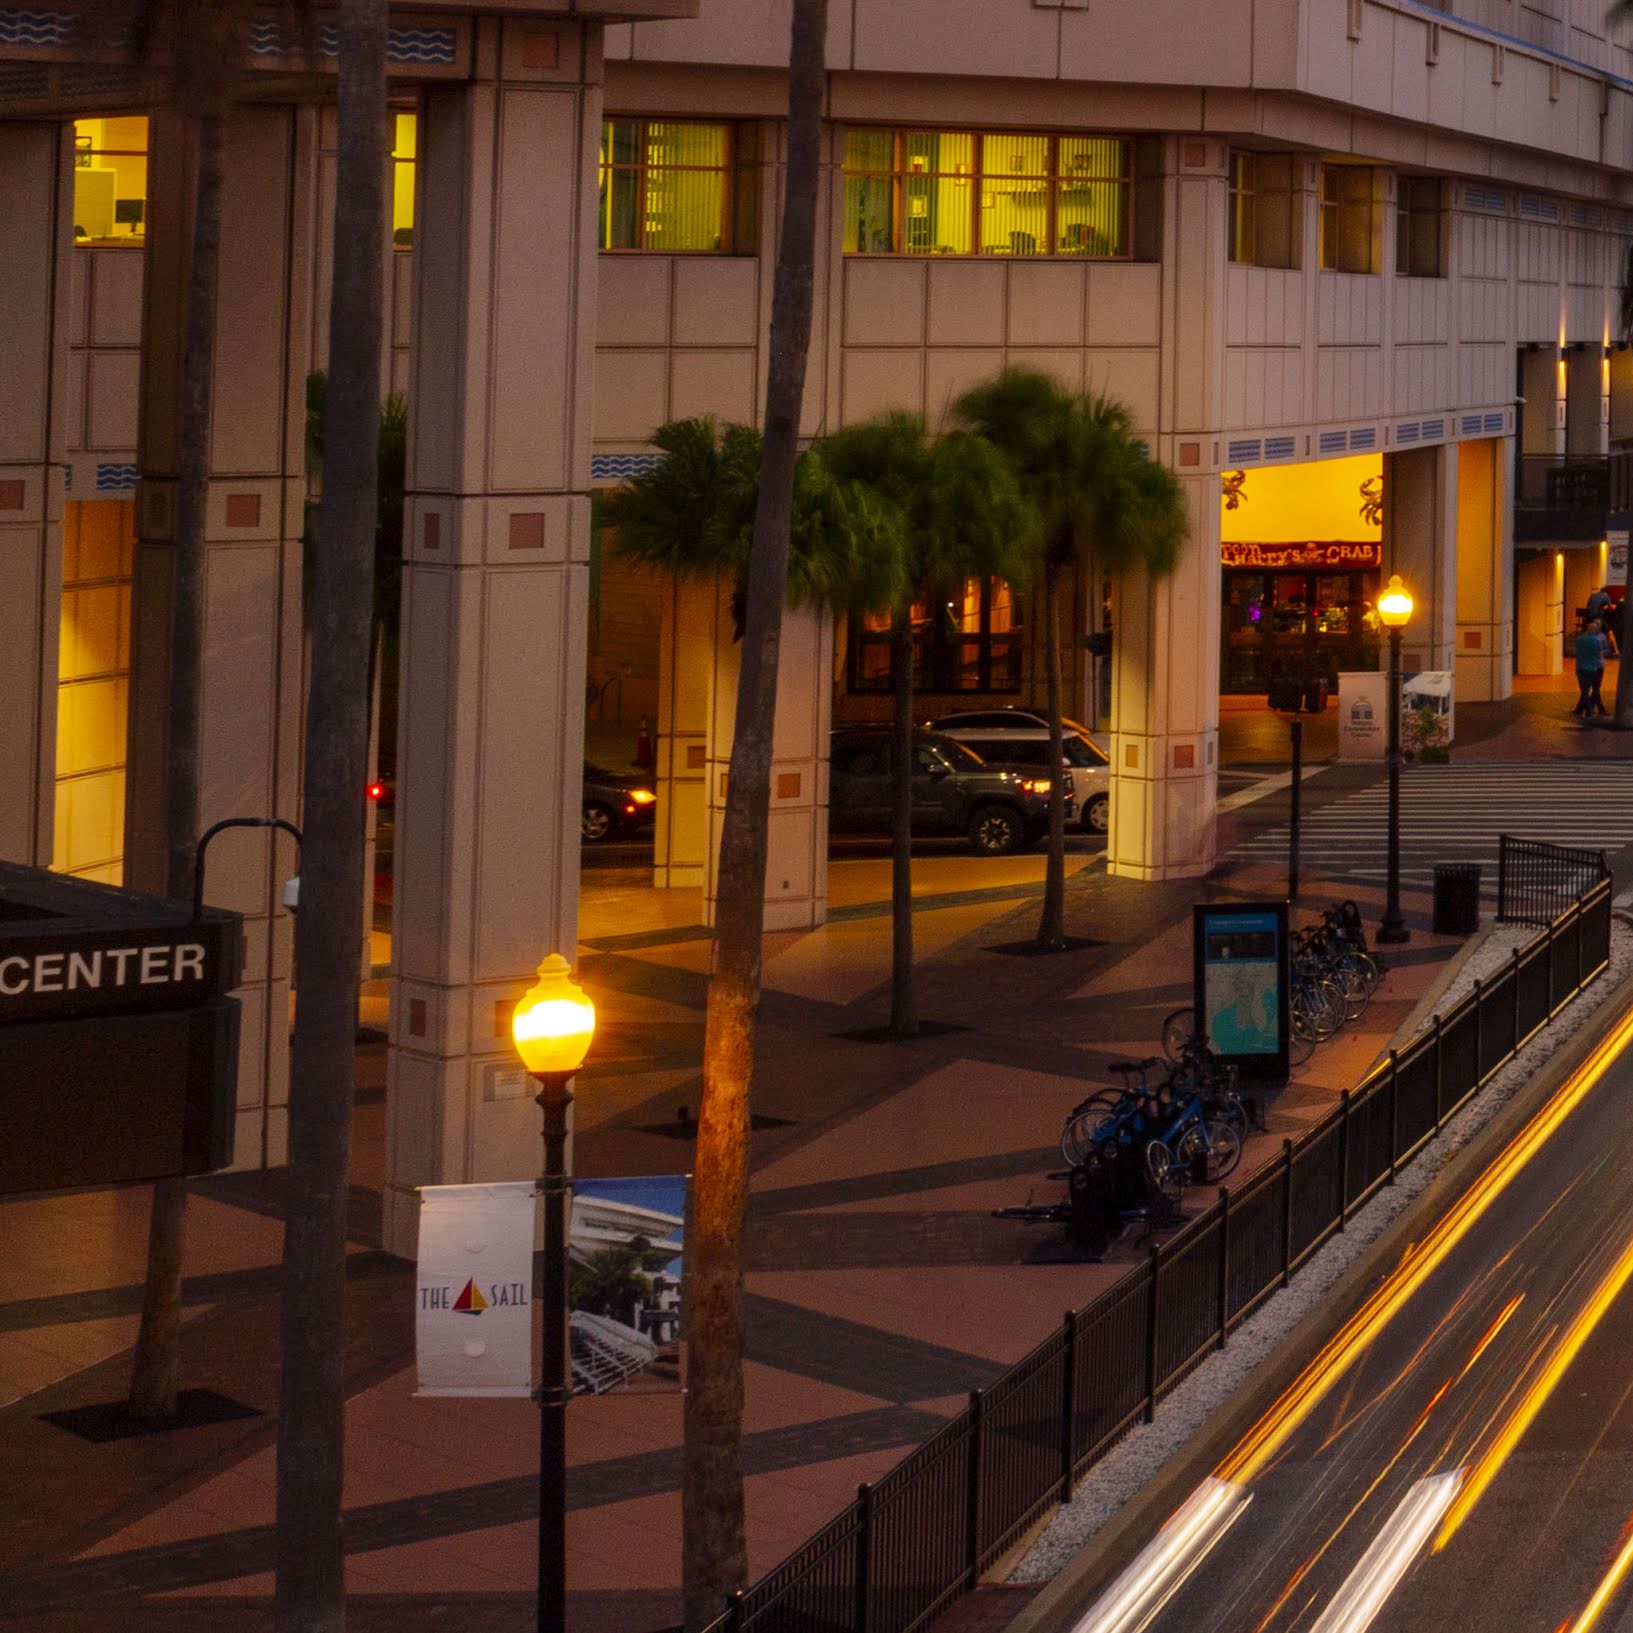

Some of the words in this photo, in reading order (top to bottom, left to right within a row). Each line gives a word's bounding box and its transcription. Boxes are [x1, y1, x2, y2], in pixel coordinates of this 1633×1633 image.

[1326, 545, 1373, 564] CRAB
[0, 943, 206, 996] CENTER
[421, 1287, 450, 1310] THE
[490, 1283, 529, 1307] SAIL
